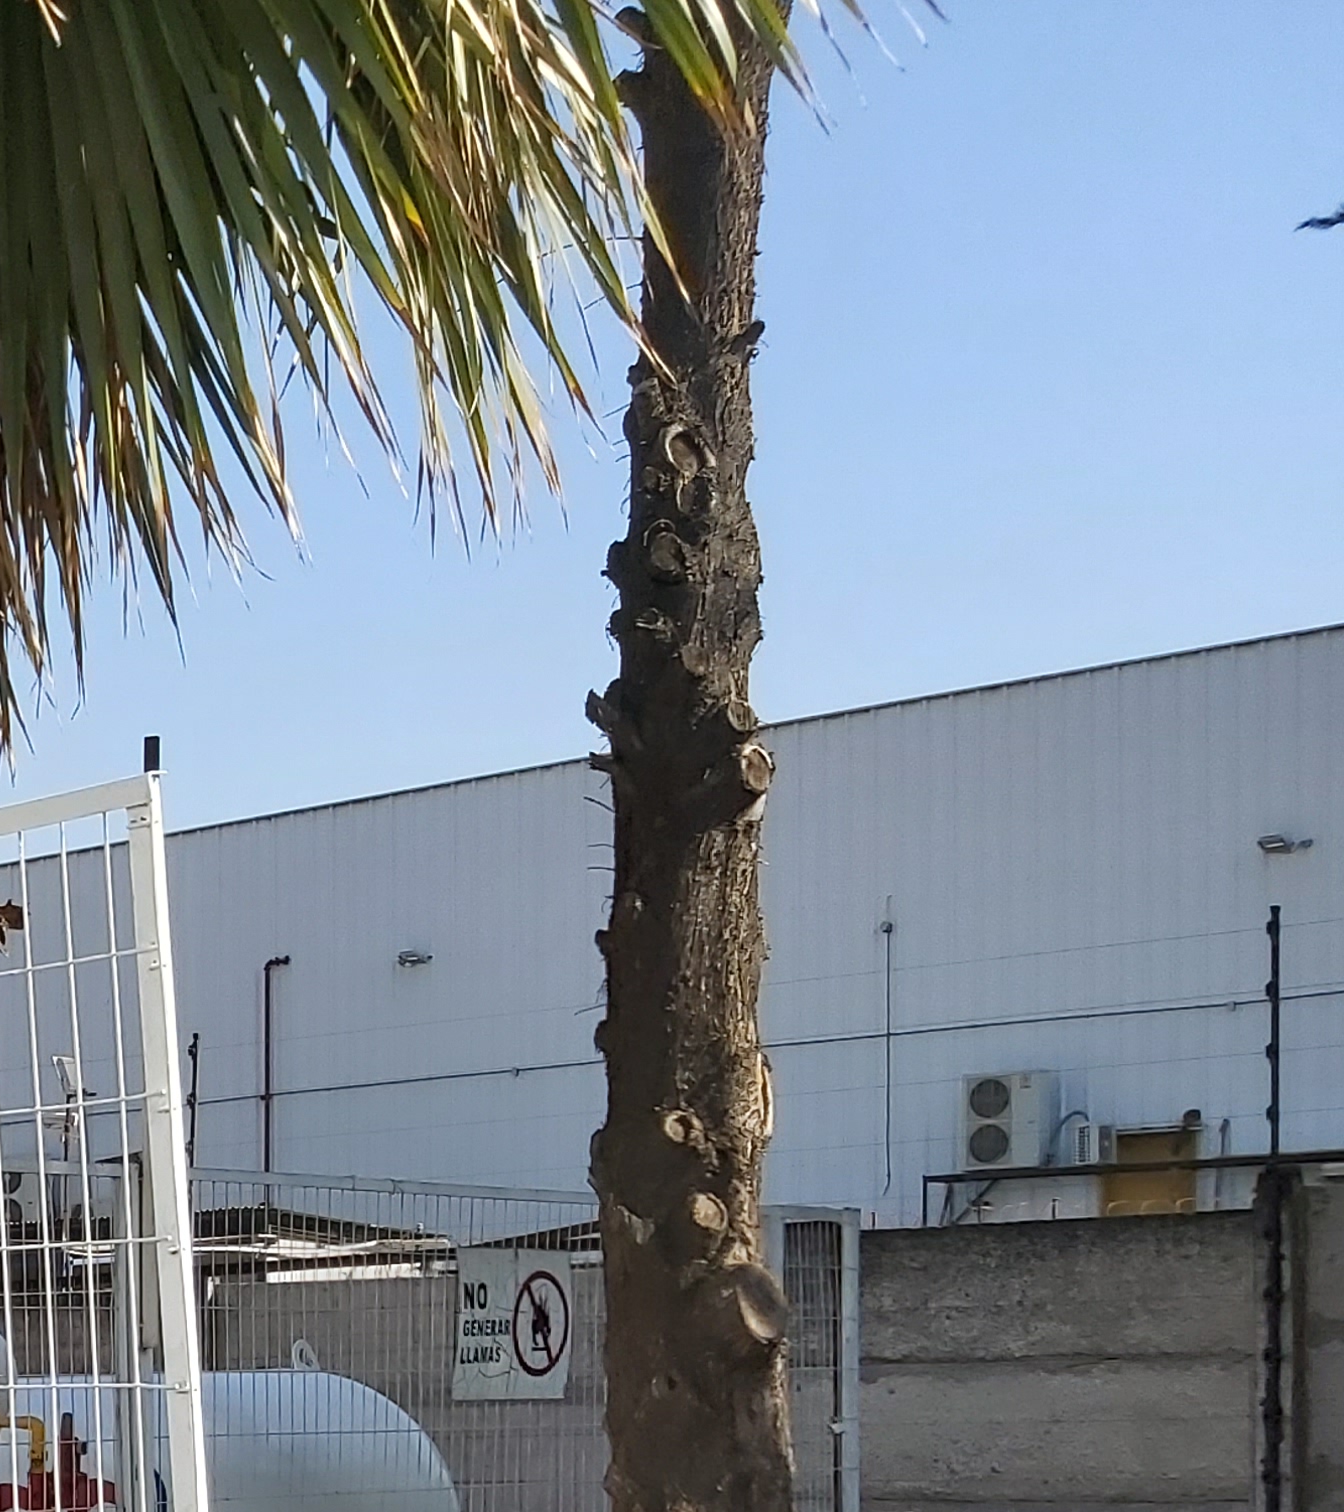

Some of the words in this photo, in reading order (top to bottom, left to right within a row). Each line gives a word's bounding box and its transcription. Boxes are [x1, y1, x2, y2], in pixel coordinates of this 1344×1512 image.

[463, 1282, 488, 1310] NO
[463, 1318, 511, 1337] GENERAR
[460, 1346, 502, 1365] LLAMAS
